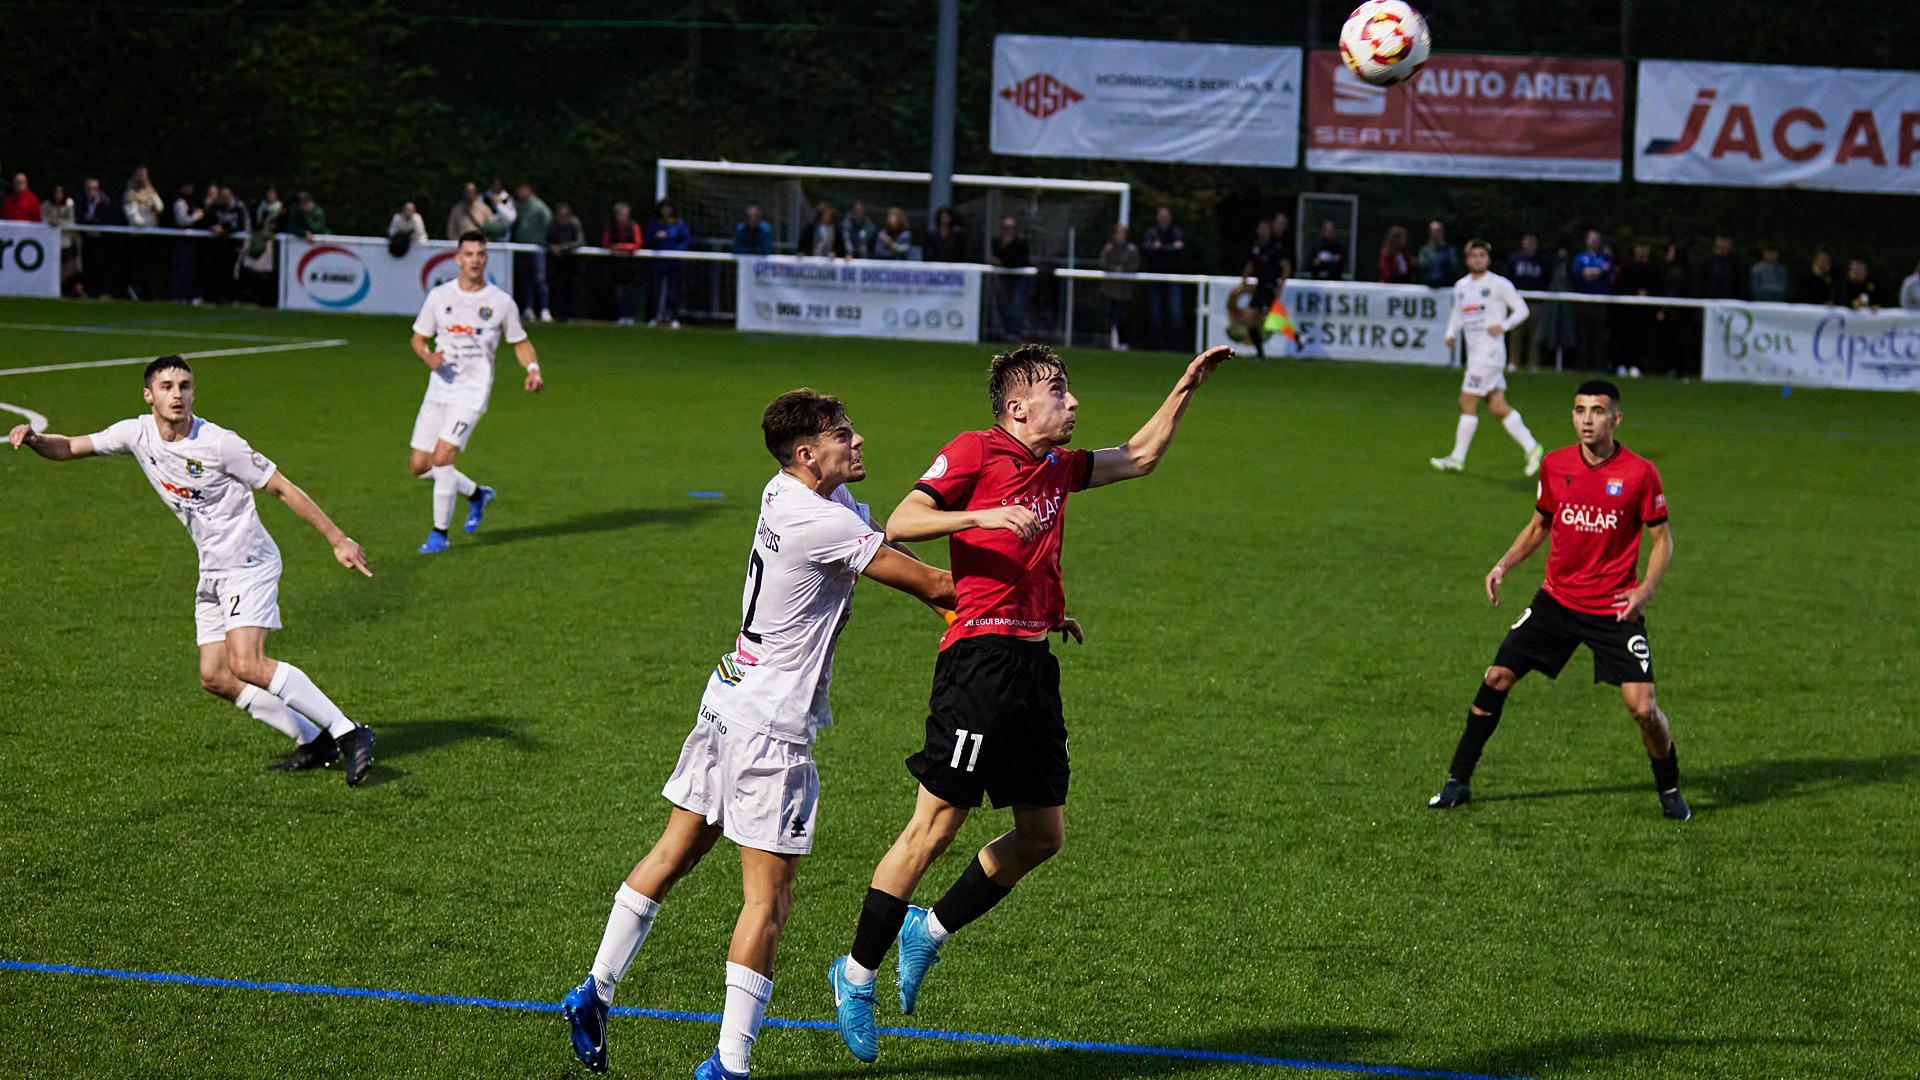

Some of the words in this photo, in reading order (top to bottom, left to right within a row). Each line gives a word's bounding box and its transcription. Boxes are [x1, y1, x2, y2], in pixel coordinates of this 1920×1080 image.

[1096, 73, 1195, 89] HORMIGONES
[1417, 69, 1505, 97] AUTO
[1512, 72, 1613, 101] ARETA
[1314, 126, 1401, 145] SEAT
[1296, 292, 1368, 316] IRISH
[1388, 296, 1437, 319] PUB
[1301, 322, 1428, 349] ESKIROZ
[1718, 308, 1797, 361] Bon
[452, 421, 468, 437] 17
[1561, 508, 1618, 530] GALAR
[229, 594, 241, 617] 2
[742, 548, 764, 645] 2
[950, 728, 984, 772] 11
